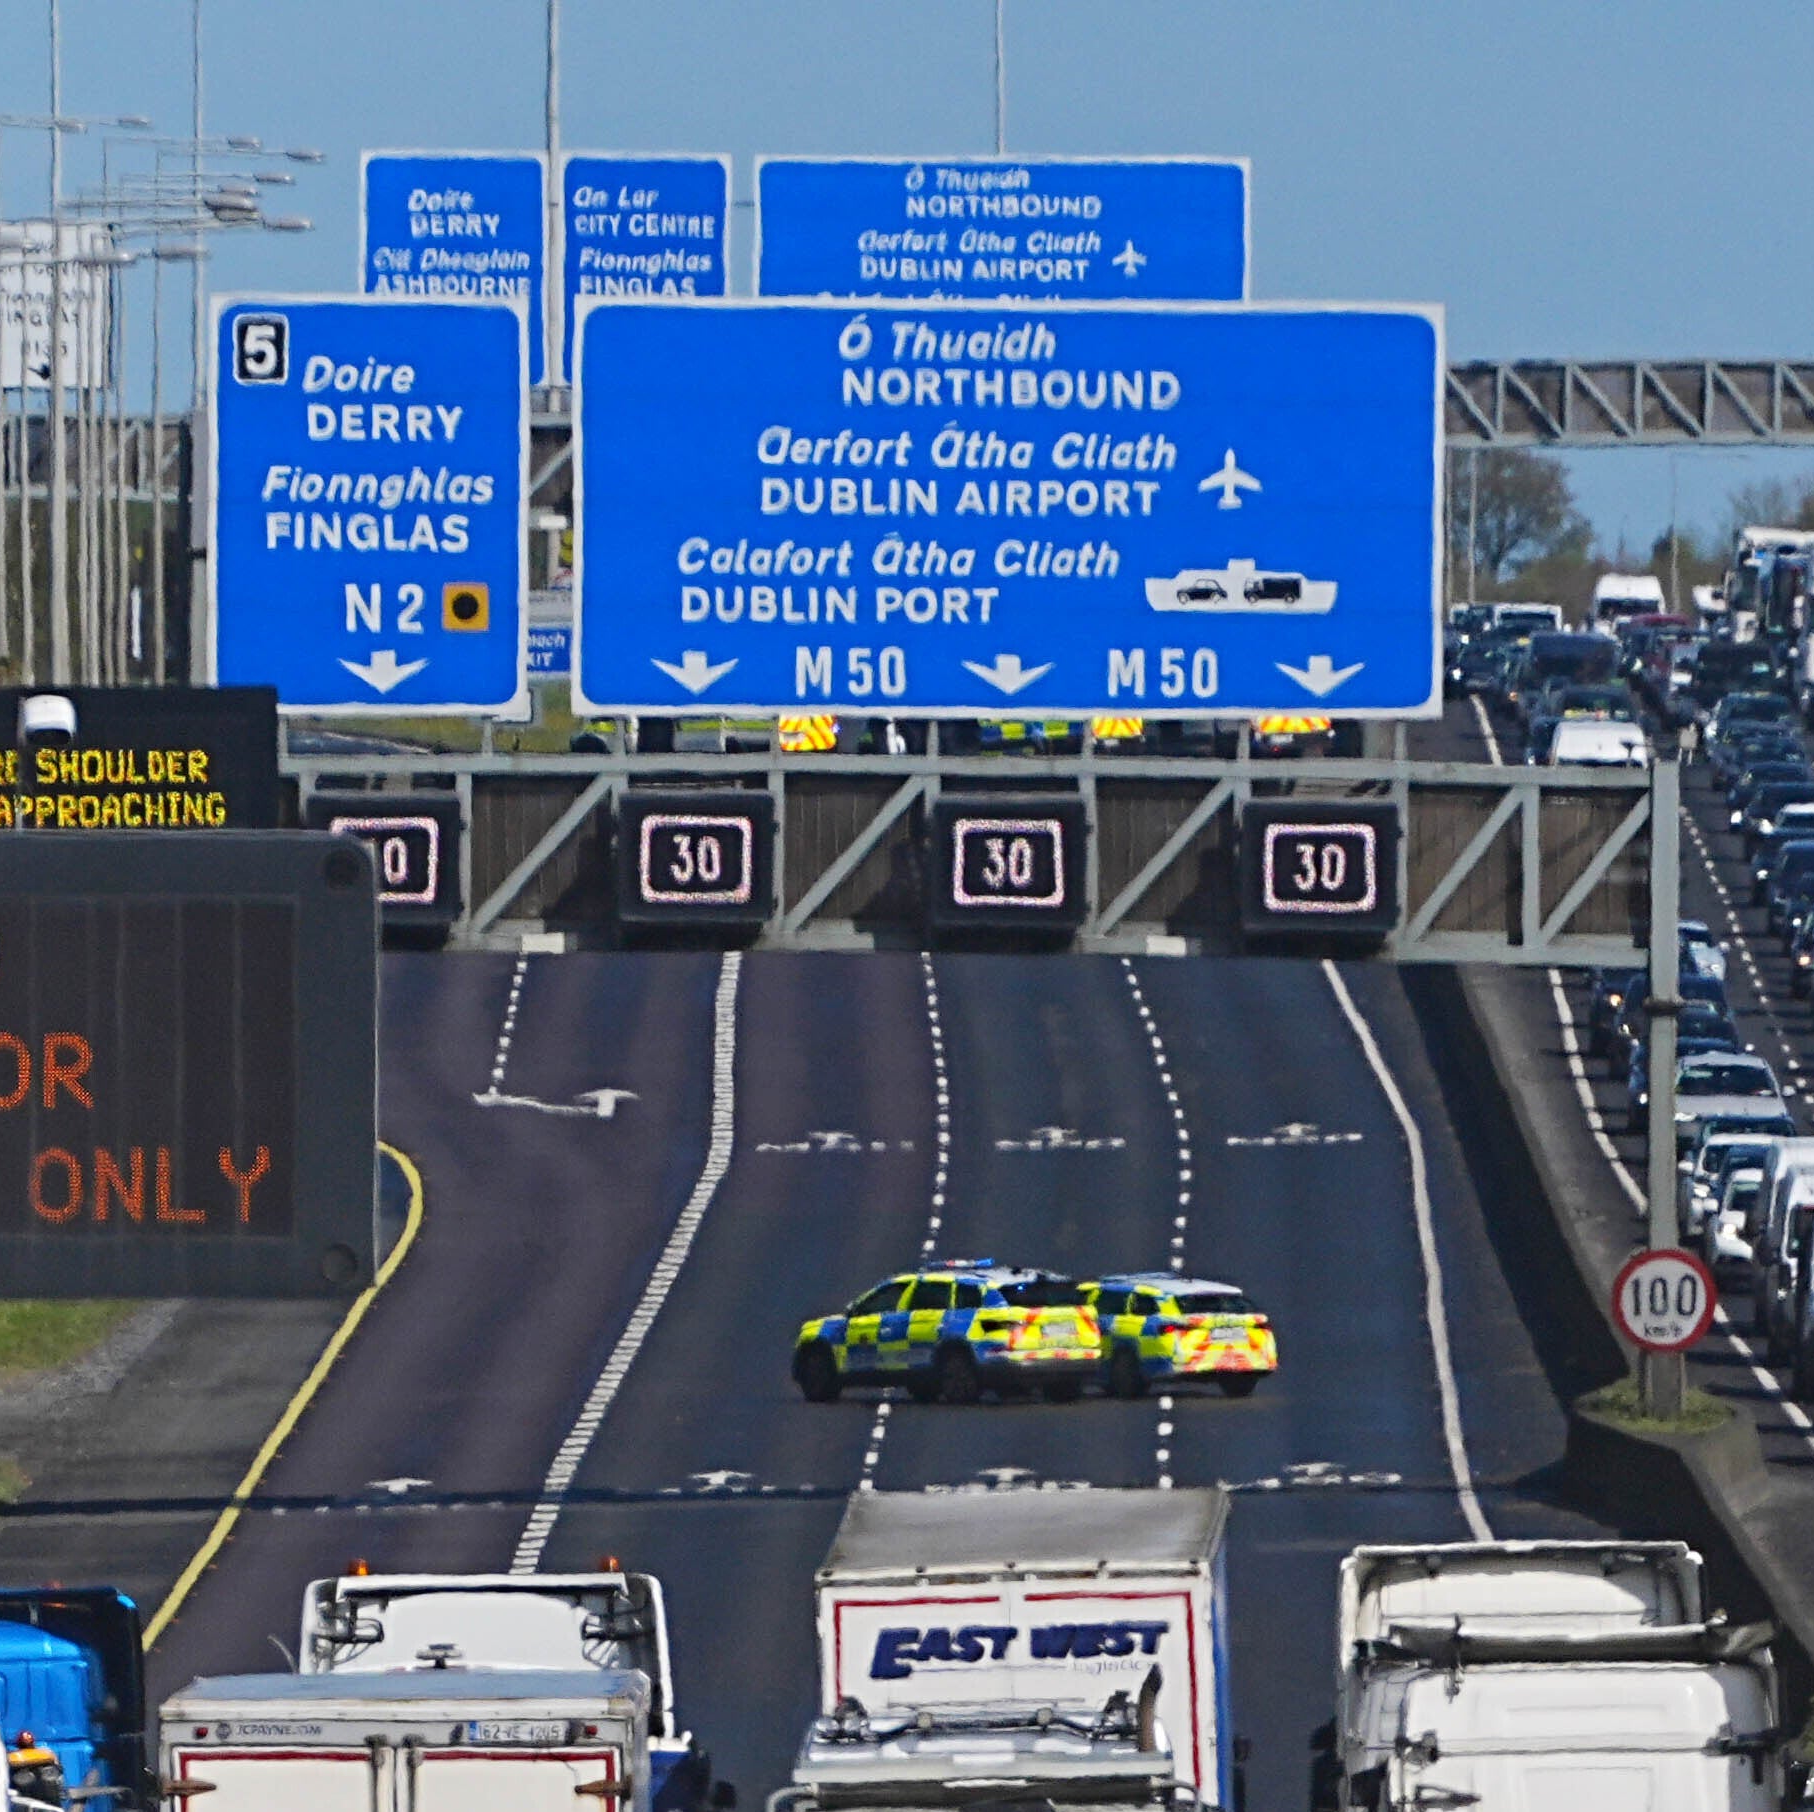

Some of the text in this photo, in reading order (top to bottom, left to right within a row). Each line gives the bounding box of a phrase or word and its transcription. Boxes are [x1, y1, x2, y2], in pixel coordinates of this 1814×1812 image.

[410, 213, 500, 238] DERRY
[574, 213, 714, 239] CITY CENTRE
[905, 195, 1102, 218] NORTHBOUND
[1026, 231, 1102, 253] Cliath
[860, 257, 1090, 282] DUBLIN AIRPORT
[245, 325, 276, 374] 5
[839, 315, 1055, 359] Ó Thuaidh
[303, 356, 414, 392] Doire
[843, 369, 1179, 408] NORTHBOUND
[308, 405, 462, 441] DERRY
[758, 427, 911, 466] Aerfort
[1053, 433, 1175, 469] Cliath
[263, 466, 493, 508] Fionnghlas
[761, 478, 1159, 515] DUBLIN AIRPORT
[267, 513, 468, 552] FINGLAS
[679, 538, 852, 575] Calafort
[995, 540, 1118, 576] Cliath
[682, 587, 998, 622] DUBLIN PORT
[36, 748, 209, 784] SHOULDER
[672, 835, 721, 884] 30
[981, 839, 1031, 887] 30
[1295, 842, 1345, 892] 30
[29, 1143, 270, 1223] ONLY
[1632, 1275, 1697, 1316] 100
[869, 1620, 1169, 1679] EAST WEST
